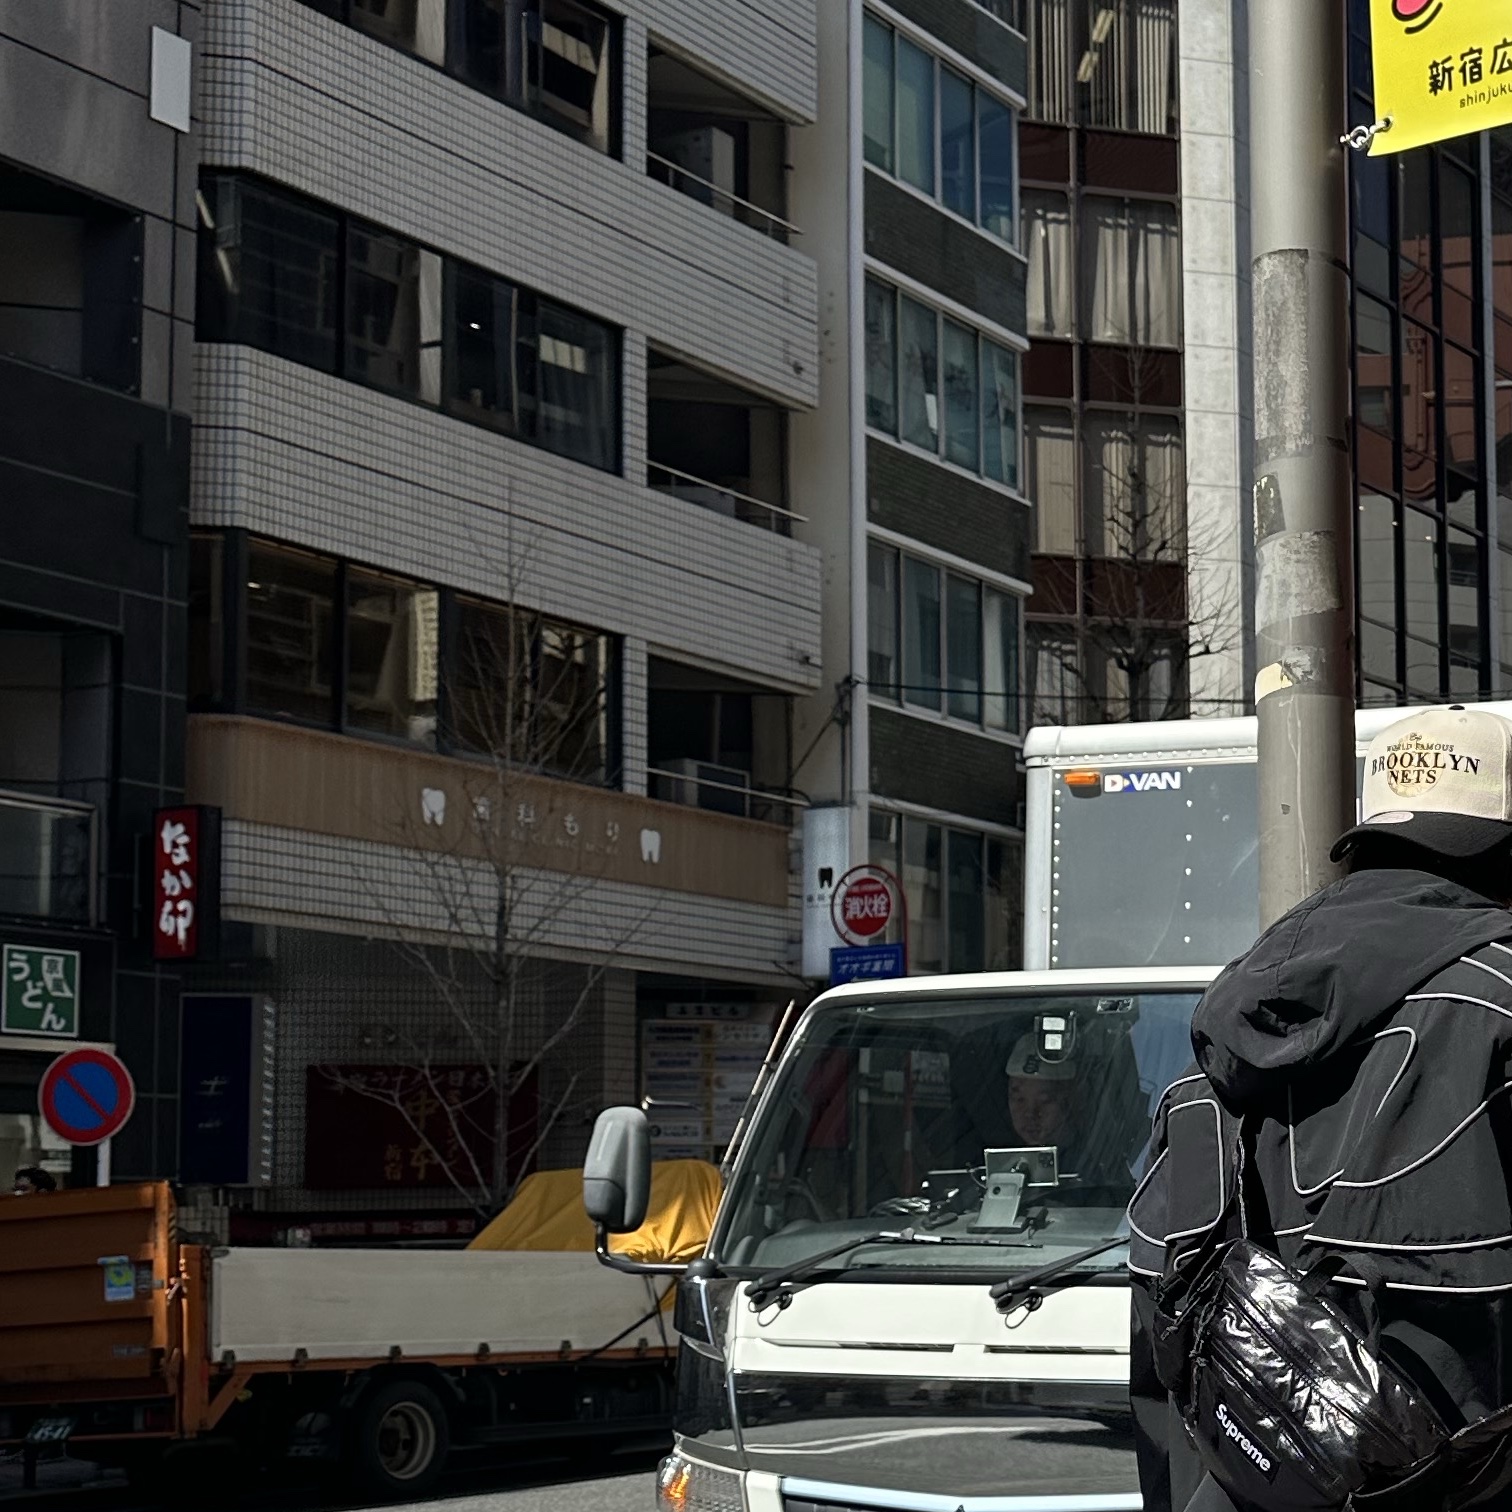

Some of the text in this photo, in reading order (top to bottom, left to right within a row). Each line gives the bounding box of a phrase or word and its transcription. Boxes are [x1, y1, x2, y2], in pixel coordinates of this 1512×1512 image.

[1414, 742, 1455, 753] FAMOUS
[1371, 751, 1481, 776] BROOKLYN
[1387, 769, 1437, 786] NETS
[845, 894, 889, 918] 消火栓
[9, 952, 67, 1031] うどん
[1215, 1403, 1271, 1471] Supreme
